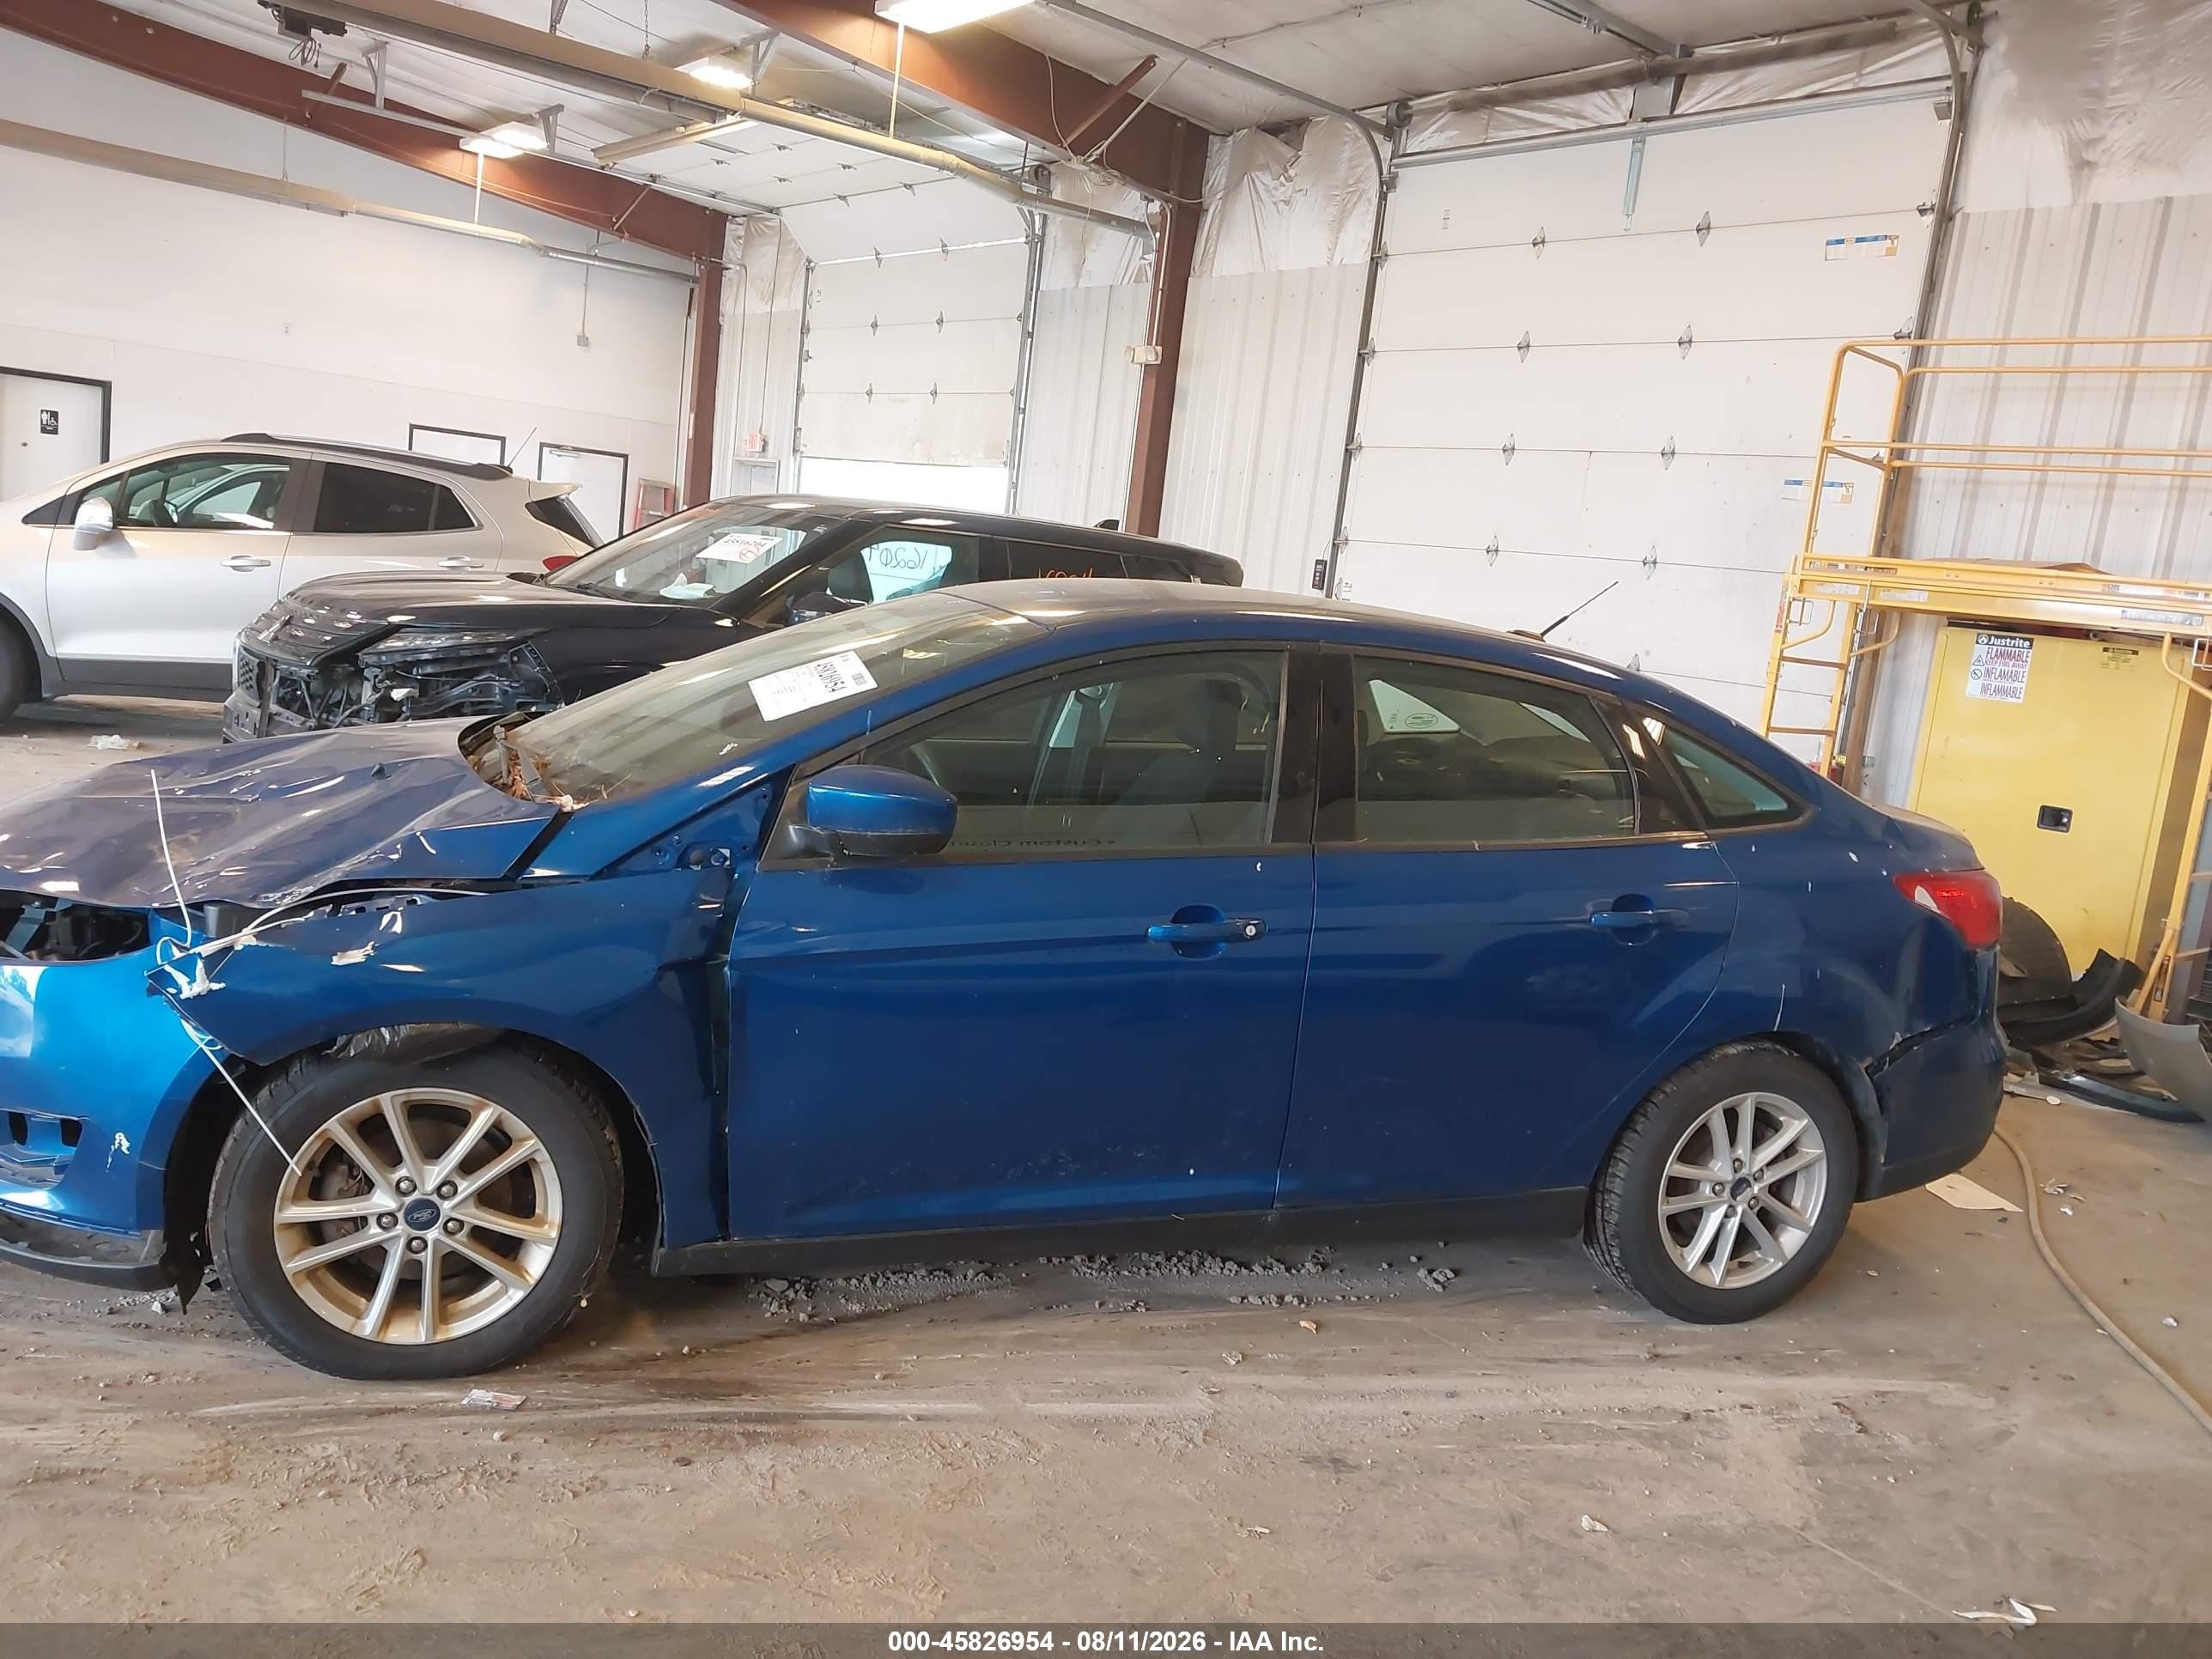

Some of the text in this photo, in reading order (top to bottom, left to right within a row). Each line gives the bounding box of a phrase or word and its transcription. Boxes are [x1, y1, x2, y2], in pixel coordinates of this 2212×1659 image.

[1989, 636, 2030, 648] Justrite
[1986, 647, 2030, 663] FLAMMABLE
[1984, 666, 2027, 683] INFLAMABLE
[1980, 682, 2023, 699] INFLAMMABLE
